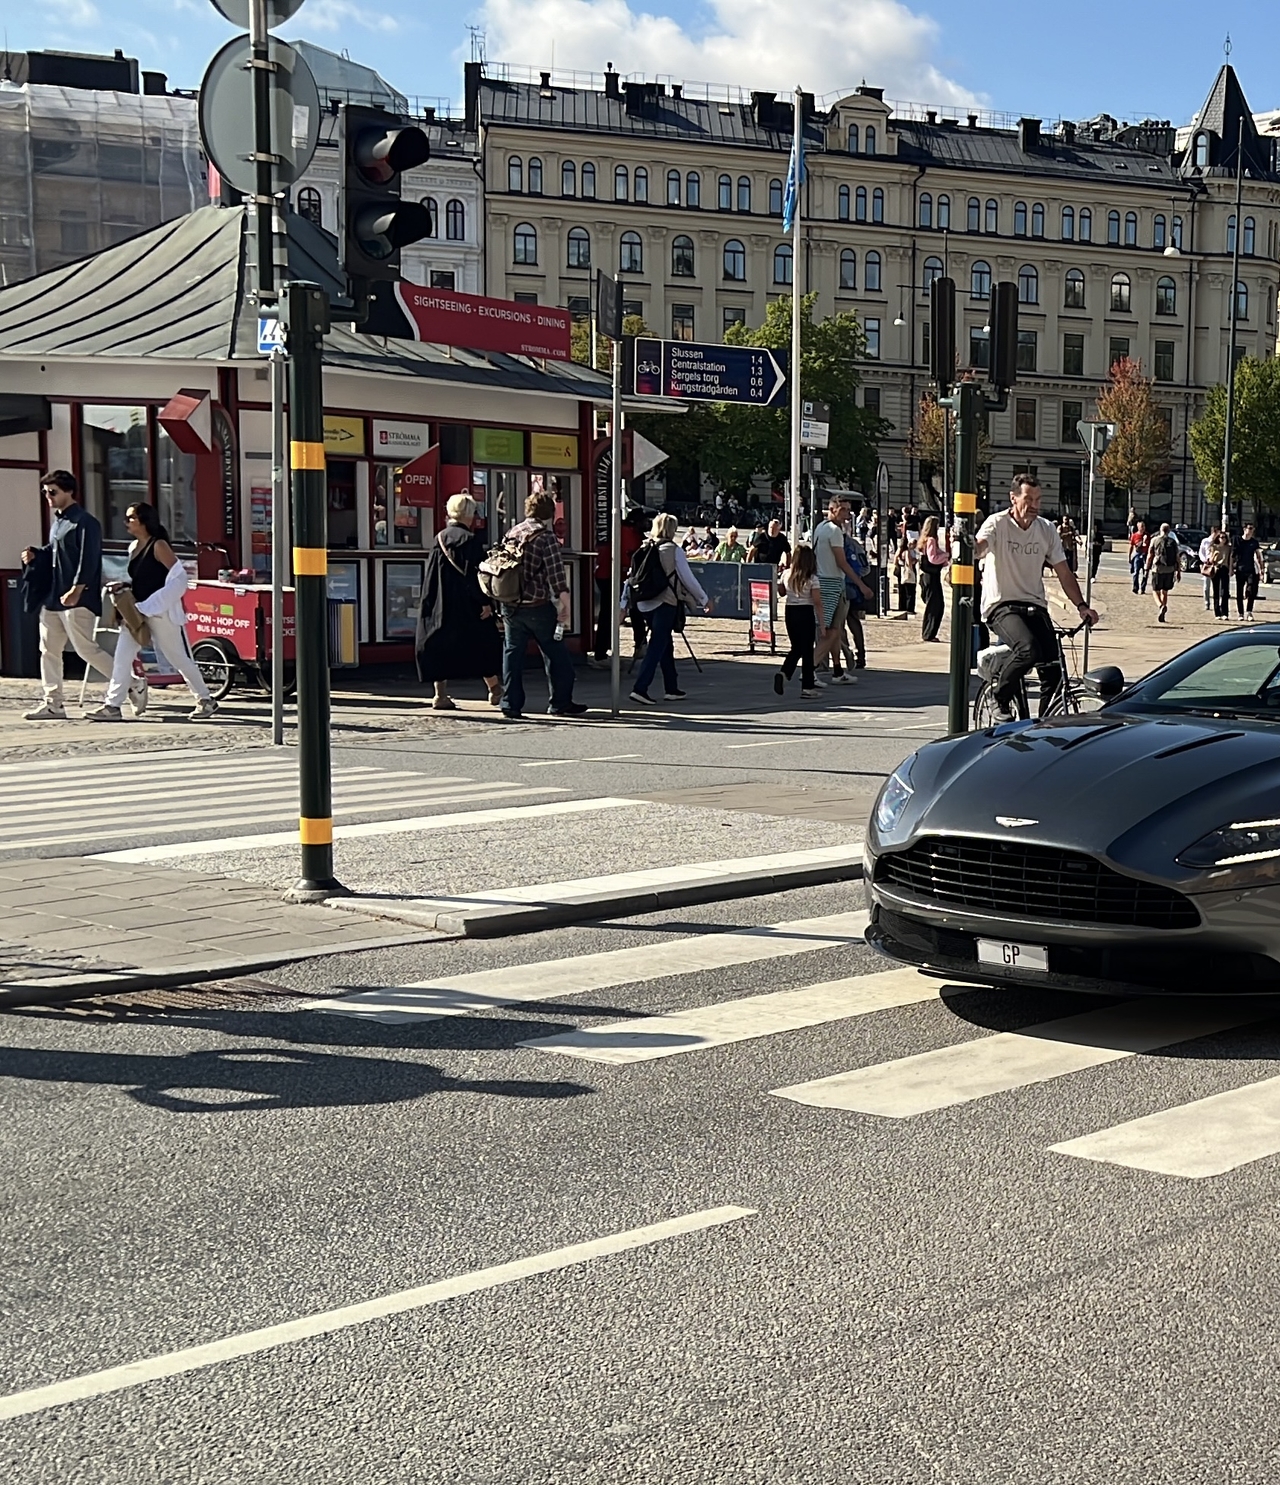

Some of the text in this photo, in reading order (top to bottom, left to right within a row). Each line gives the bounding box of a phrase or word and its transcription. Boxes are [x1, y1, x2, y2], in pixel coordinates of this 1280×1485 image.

[414, 295, 566, 329] SIGHTSEEING EXCURSIONS DINING
[671, 347, 763, 365] Slussen 1,4
[671, 359, 763, 376] Centralstation 1,3
[671, 370, 763, 387] Sergels torg 0,6
[671, 381, 763, 397] Kungsträdgården 0,4
[405, 474, 432, 485] OPEN
[1007, 540, 1039, 555] TRYGG
[199, 614, 212, 624] ON
[216, 616, 234, 627] HOP
[234, 618, 251, 629] OFF
[196, 624, 210, 633] BUS
[217, 627, 236, 636] BOAT
[1002, 944, 1020, 965] GP
